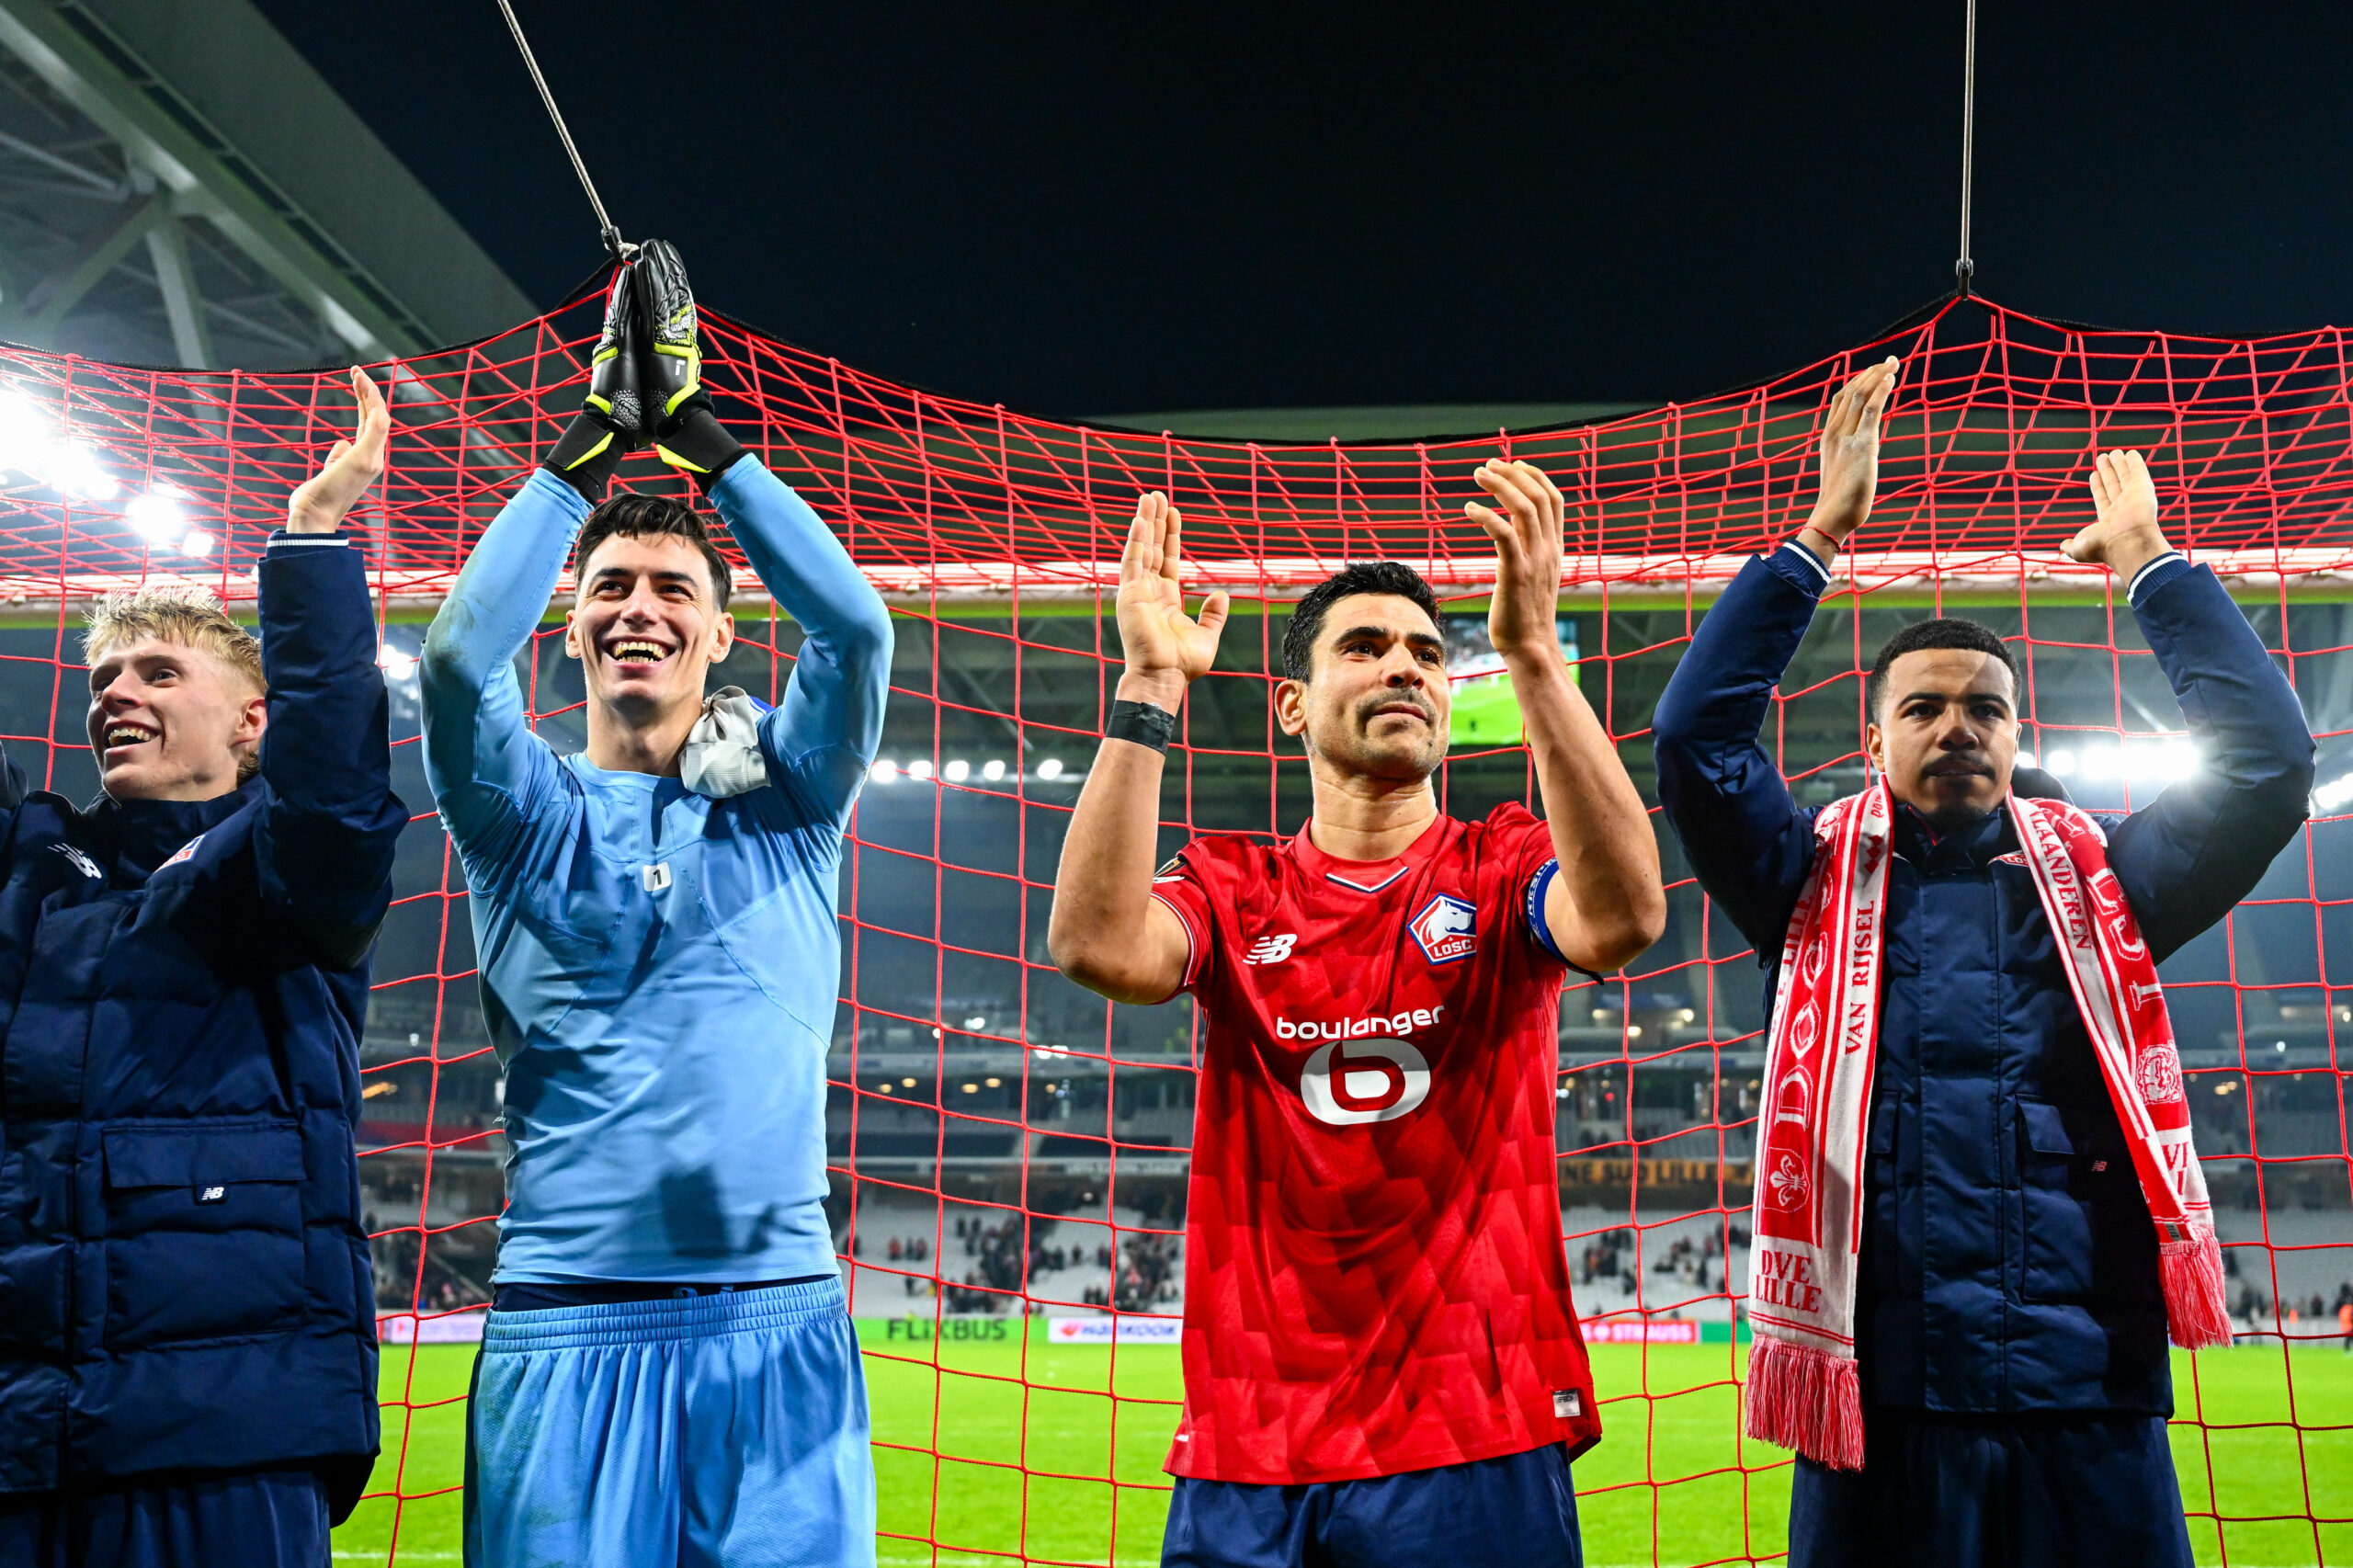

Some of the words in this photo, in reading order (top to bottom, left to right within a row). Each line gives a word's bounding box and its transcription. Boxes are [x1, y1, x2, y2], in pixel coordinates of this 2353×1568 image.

[653, 869, 663, 886] 1
[2029, 810, 2093, 950] VLAANDEREN
[1434, 938, 1473, 958] LOSC
[1851, 899, 1876, 987] RIJSEL
[1276, 1005, 1446, 1040] boulanger
[1845, 1002, 1866, 1056] VAN
[1761, 1249, 1812, 1285] DVE
[1756, 1274, 1822, 1314] LILLE
